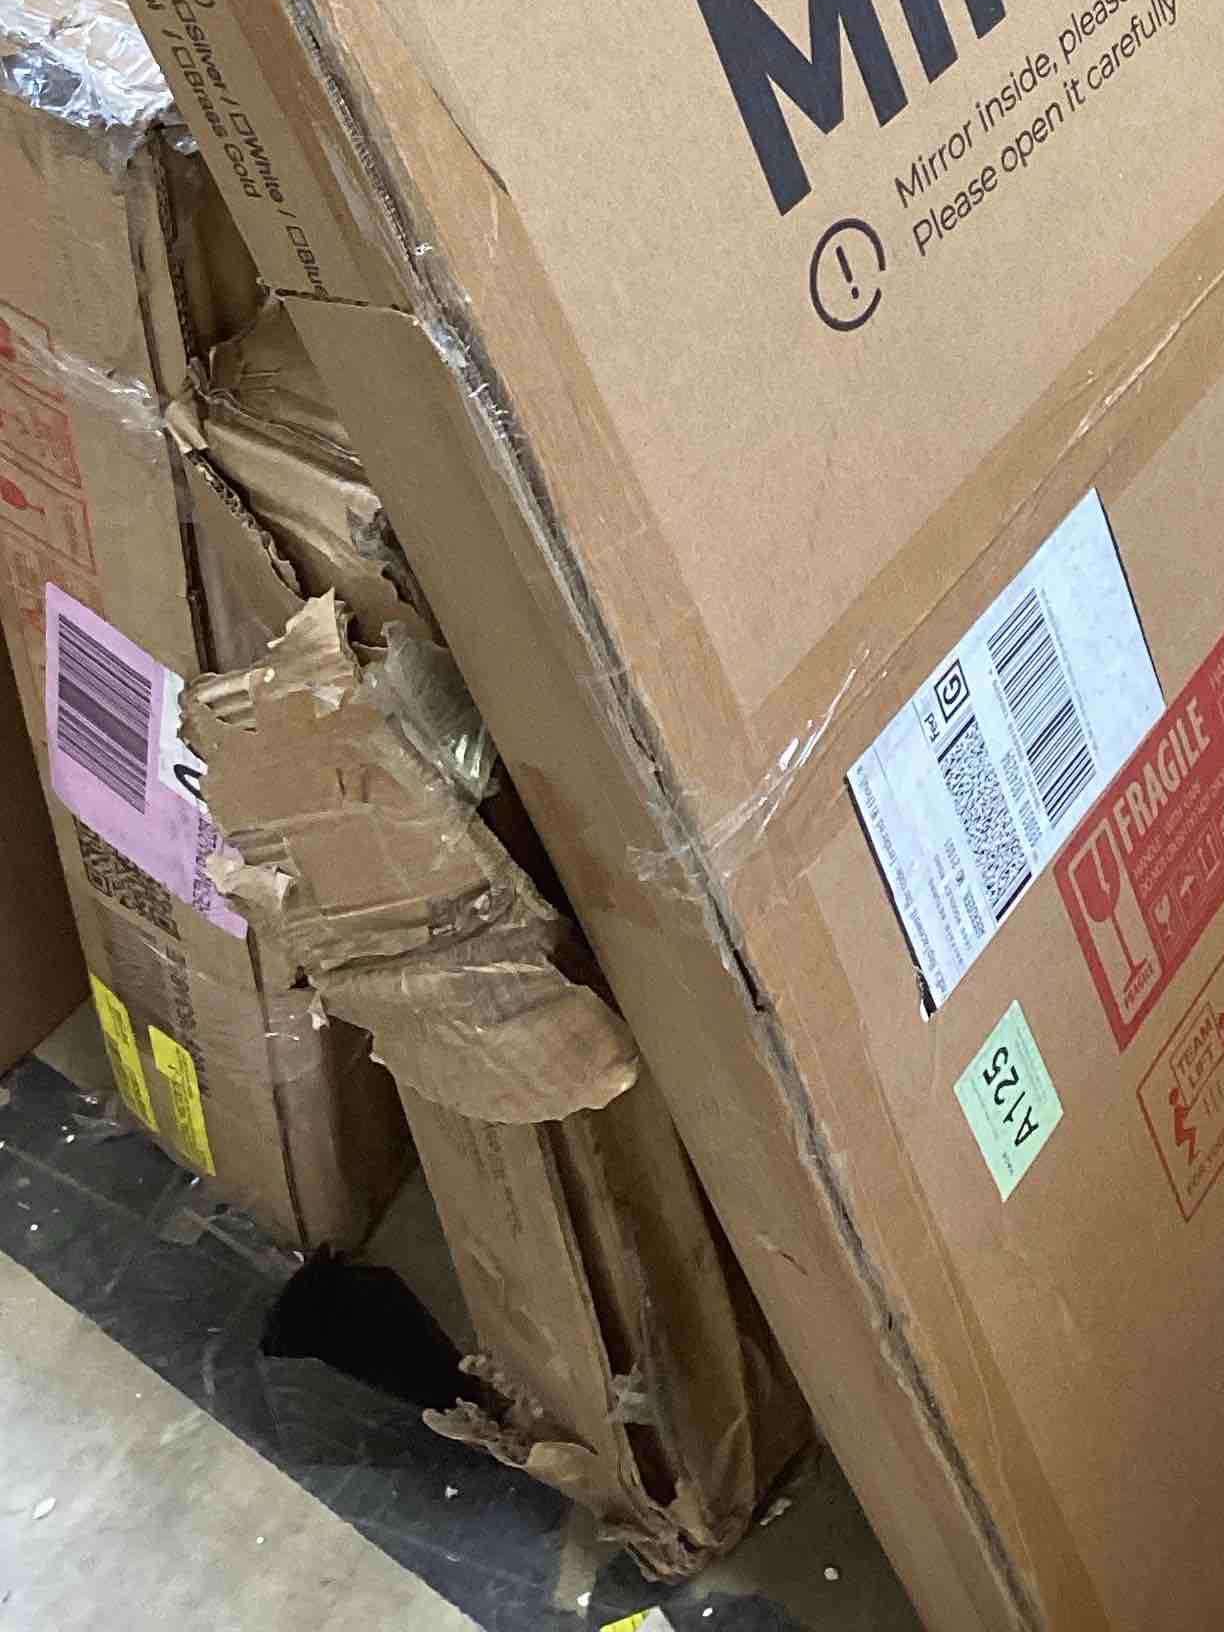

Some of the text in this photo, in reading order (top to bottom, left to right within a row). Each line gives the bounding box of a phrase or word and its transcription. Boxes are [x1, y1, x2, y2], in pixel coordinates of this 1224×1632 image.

[223, 142, 263, 200] Gold
[893, 118, 977, 209] Mirror
[975, 53, 1058, 134] inside,
[911, 165, 1000, 257] Please
[1000, 100, 1065, 176] open
[1064, 81, 1087, 114] it
[941, 673, 963, 707] G
[1114, 696, 1213, 843] FRAGILE
